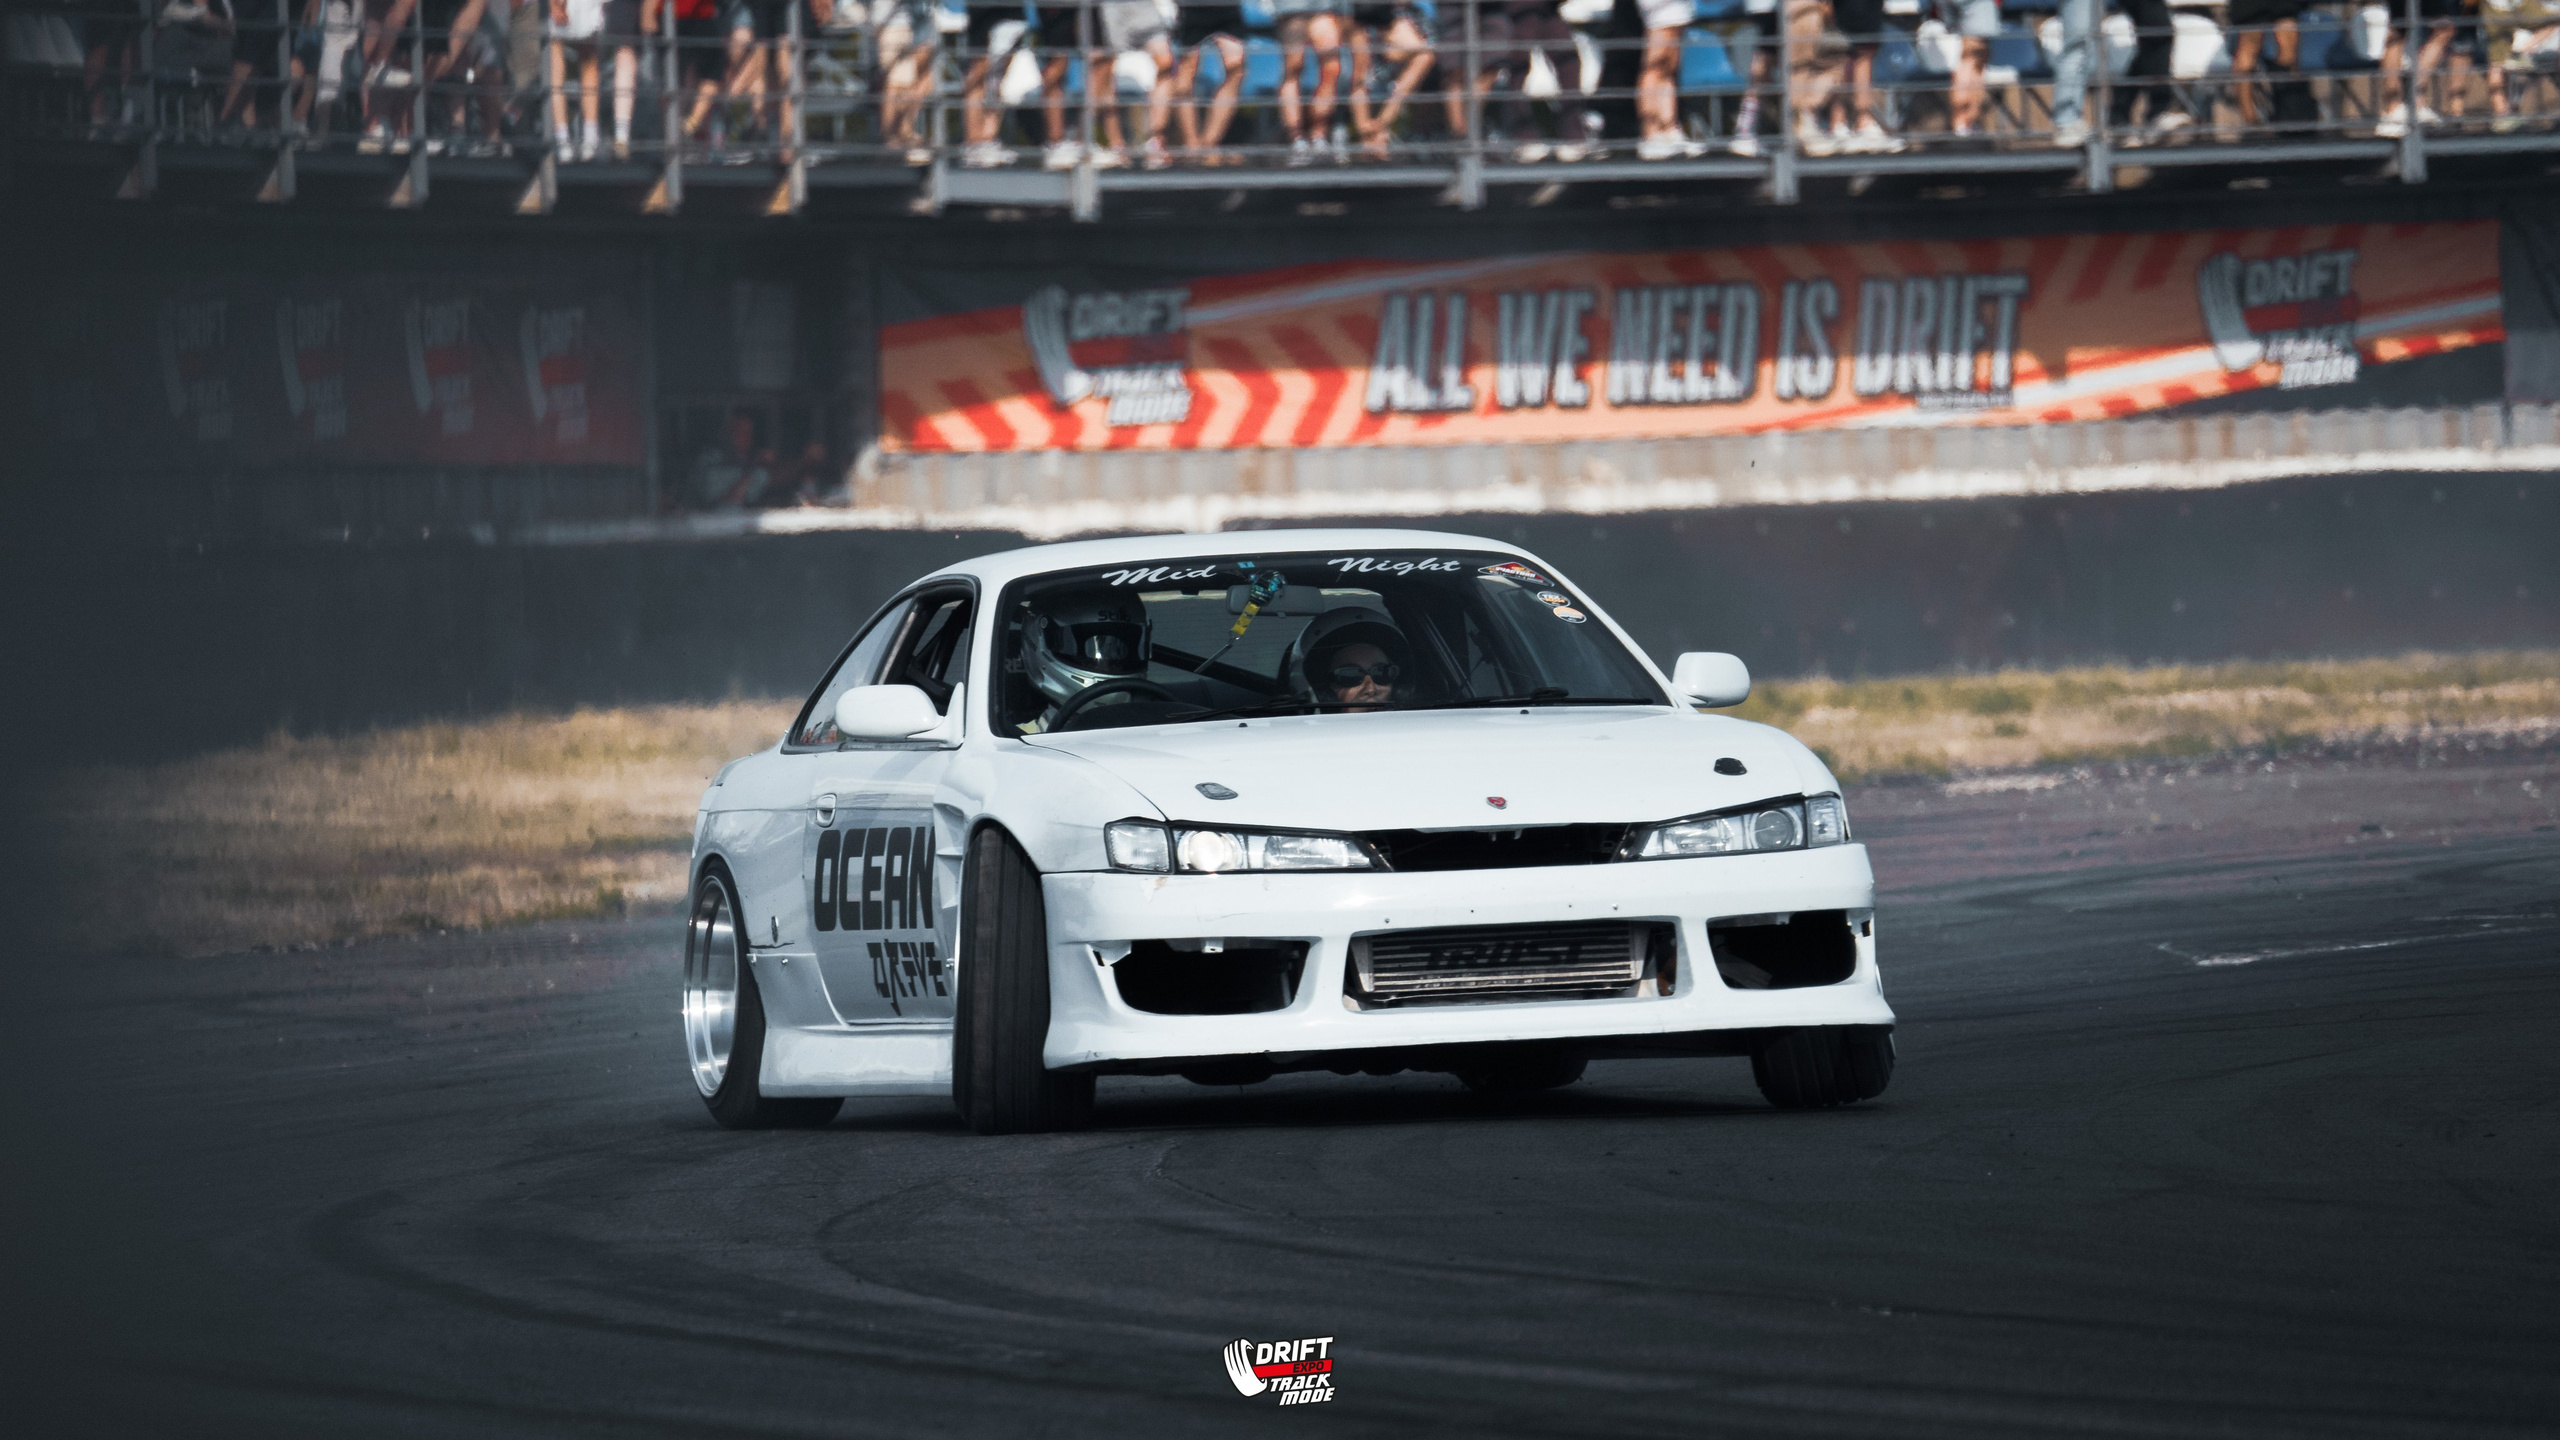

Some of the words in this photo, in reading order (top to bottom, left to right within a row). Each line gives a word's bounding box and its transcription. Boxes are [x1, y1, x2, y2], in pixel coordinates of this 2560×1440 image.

[2247, 249, 2356, 305] DRIFT
[1071, 288, 1191, 341] DRIFT
[1366, 291, 1475, 411] ALL
[1496, 289, 1595, 408] WE
[1607, 284, 1759, 404] NEED
[1775, 279, 1840, 398] IS
[1854, 274, 2029, 395] DRIFT
[1102, 564, 1217, 586] Mid
[1327, 557, 1461, 576] Night
[814, 826, 937, 932] OCEAN
